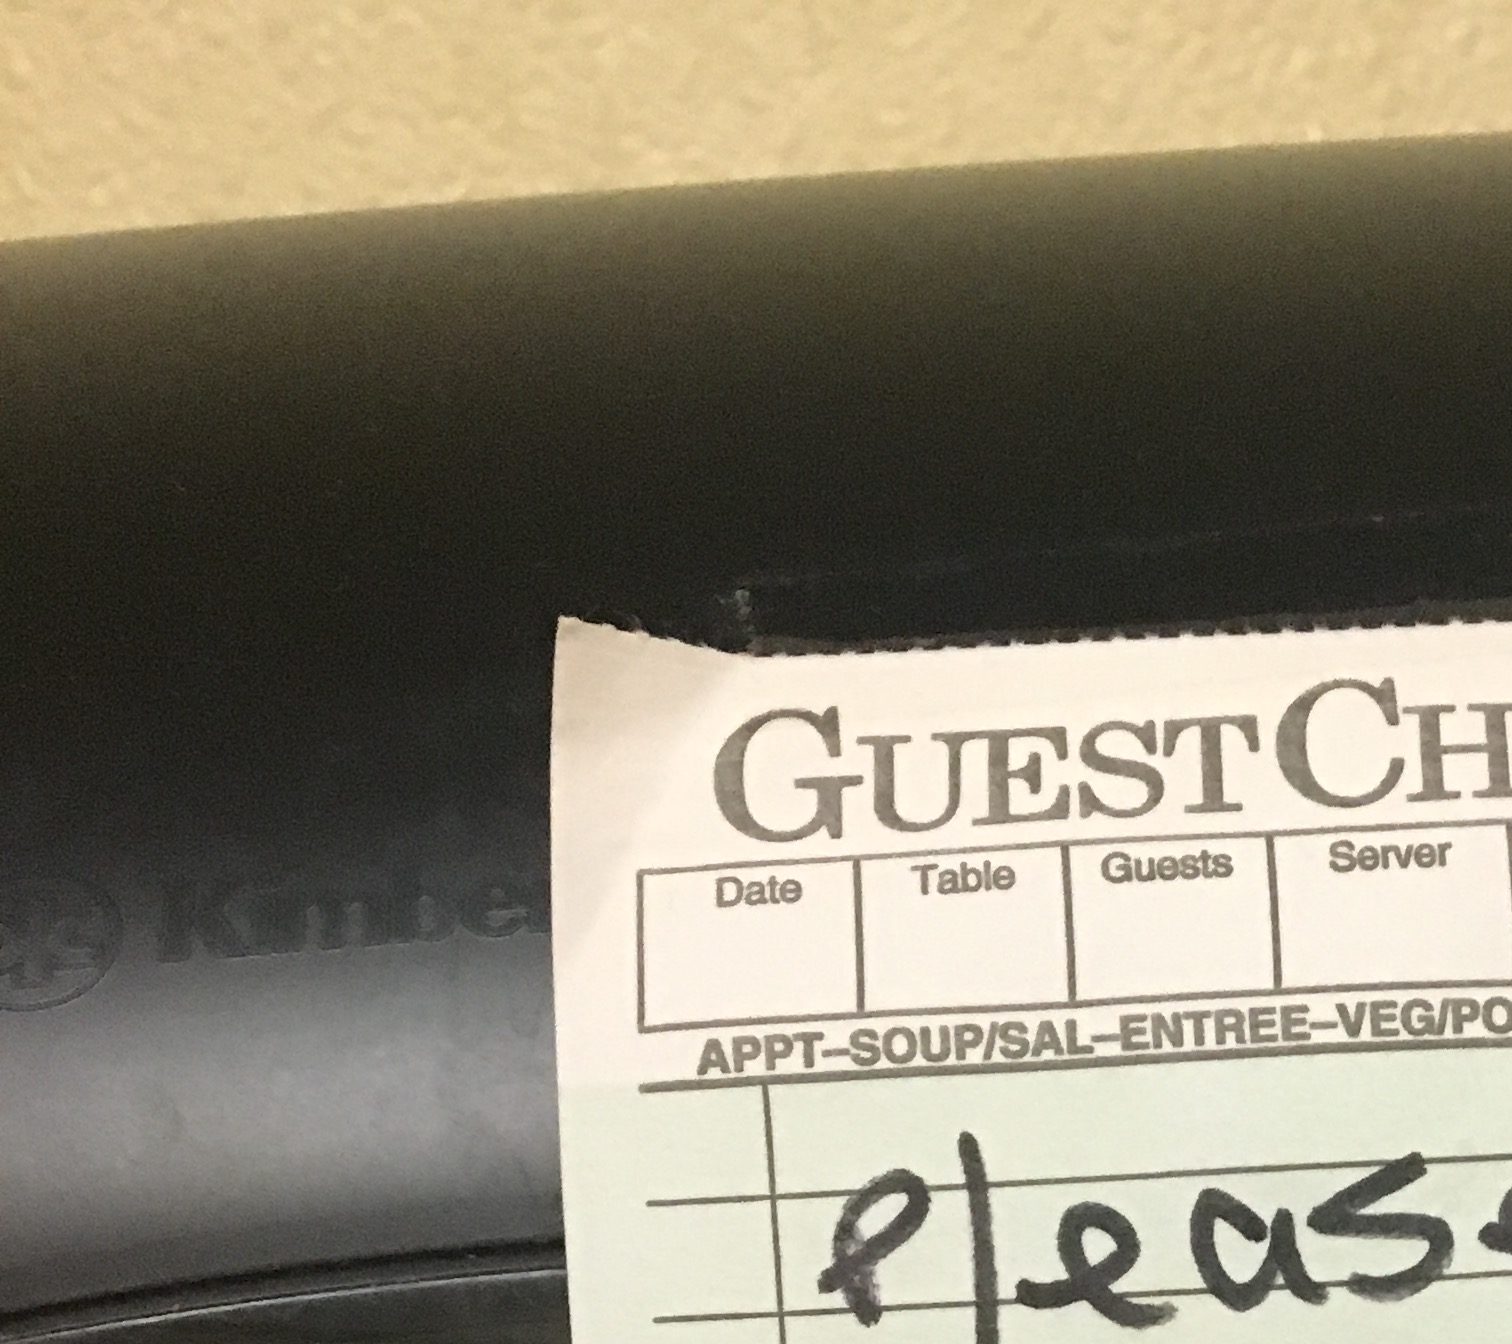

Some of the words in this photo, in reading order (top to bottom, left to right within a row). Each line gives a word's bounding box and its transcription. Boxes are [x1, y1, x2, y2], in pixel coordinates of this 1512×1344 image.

[1100, 848, 1235, 884] Guests
[1328, 839, 1453, 873] Server
[714, 874, 803, 908] Date
[911, 860, 1017, 896] Table
